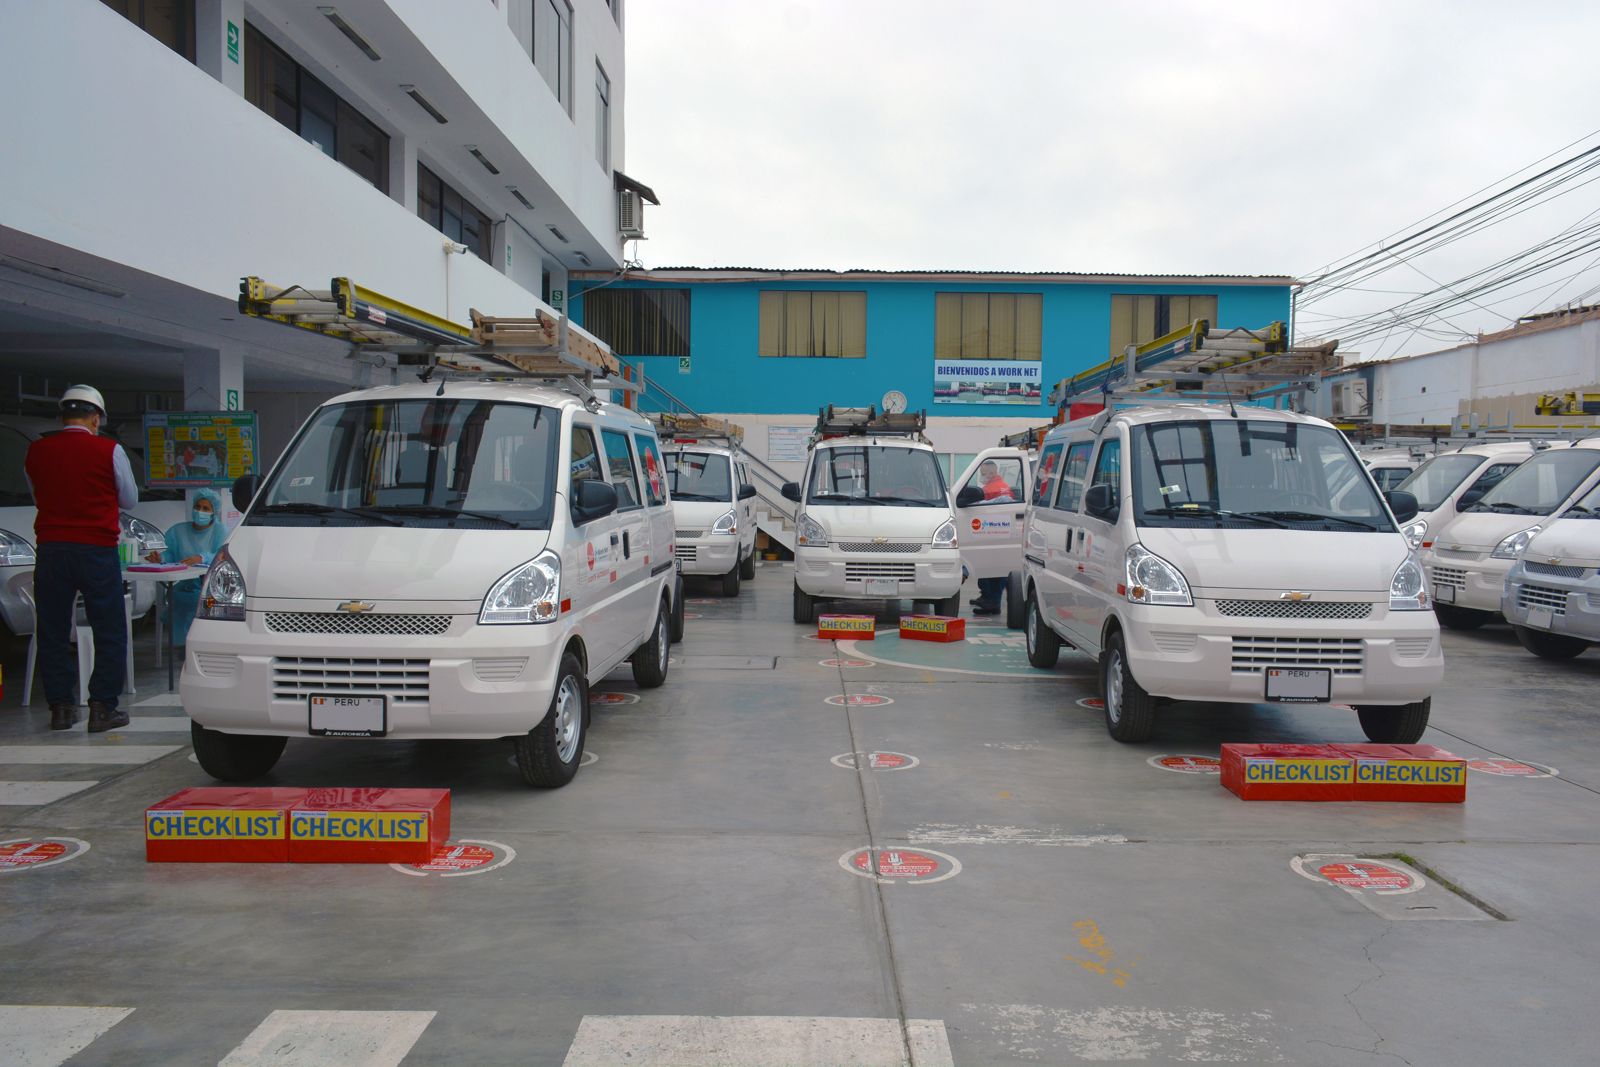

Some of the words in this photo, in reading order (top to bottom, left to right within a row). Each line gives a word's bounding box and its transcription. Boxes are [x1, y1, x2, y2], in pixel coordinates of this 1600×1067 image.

[554, 291, 562, 300] S
[937, 366, 990, 376] BIENVENIDOS
[991, 367, 997, 376] A
[998, 367, 1023, 377] WORK
[1024, 368, 1039, 377] NET
[229, 391, 238, 411] S
[334, 698, 360, 706] PERU
